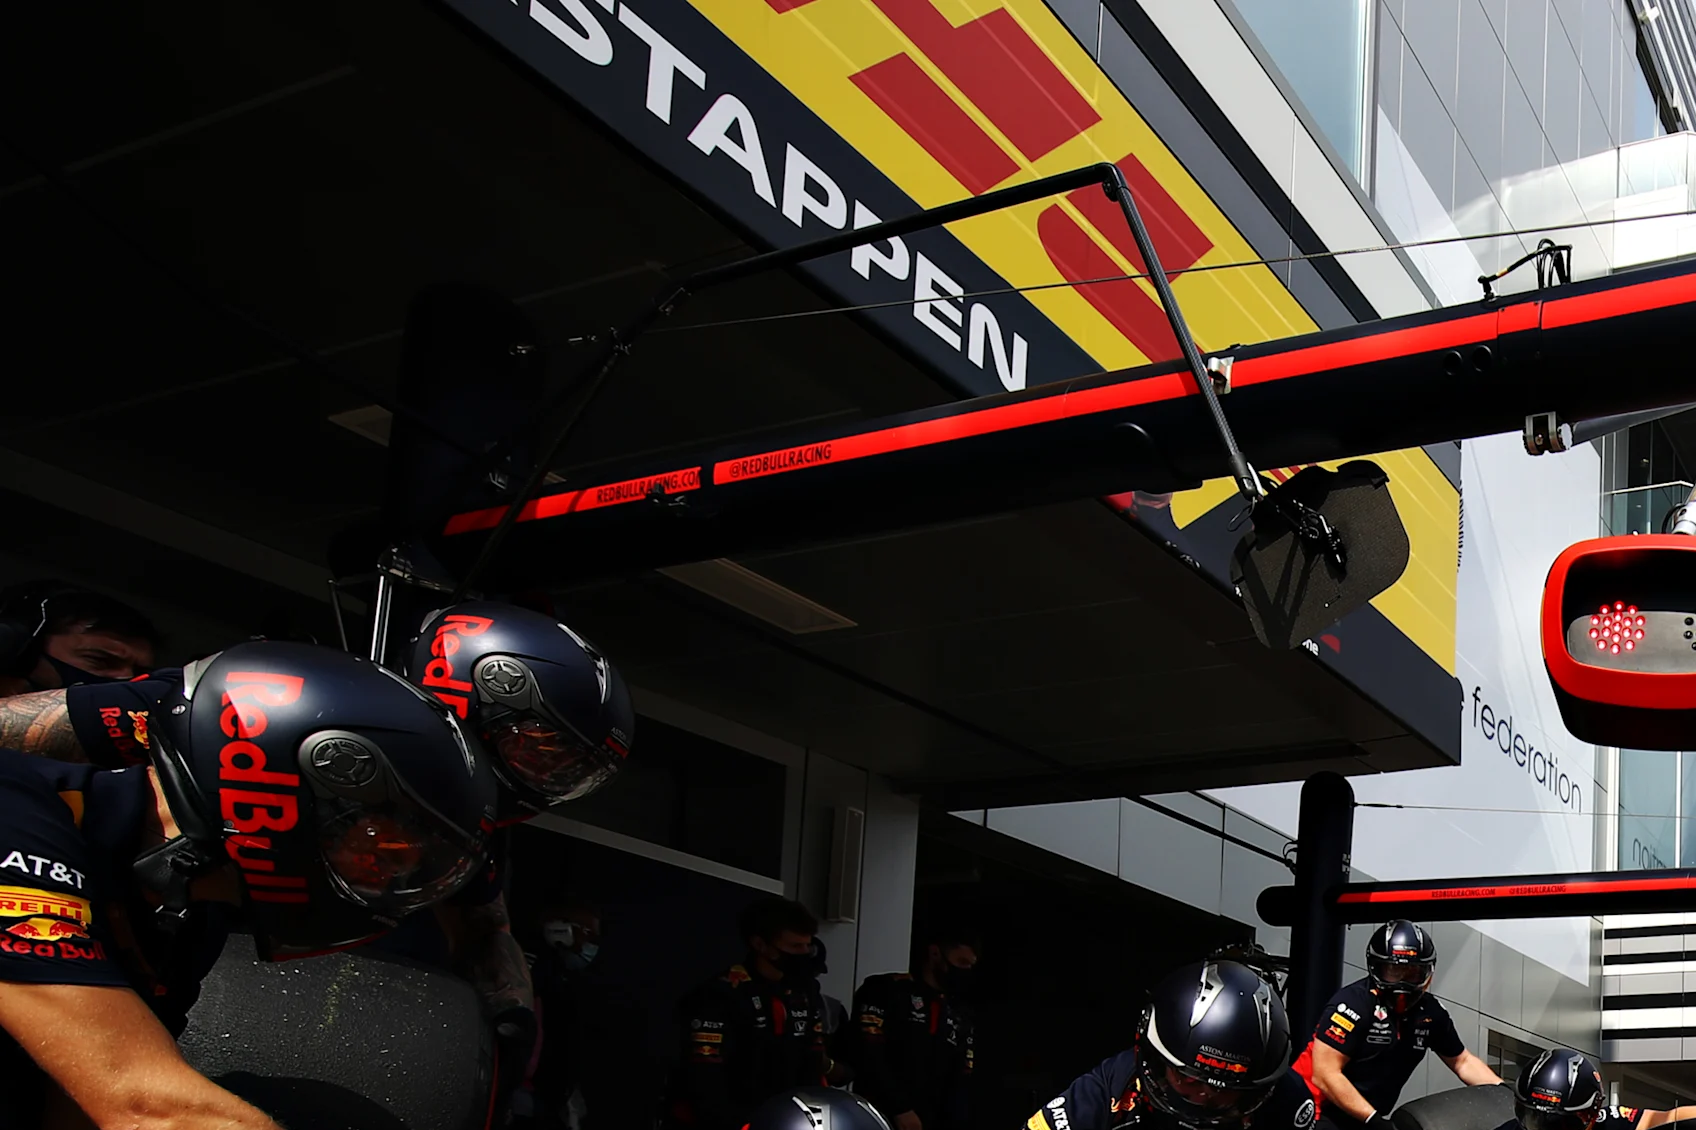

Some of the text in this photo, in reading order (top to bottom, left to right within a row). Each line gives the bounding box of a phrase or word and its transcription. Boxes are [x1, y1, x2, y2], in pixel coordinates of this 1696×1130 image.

[510, 0, 1027, 392] STAPPEN
[729, 443, 832, 478] @REDBULLRACING
[1472, 686, 1582, 816] federation
[1, 850, 86, 890] AT&T
